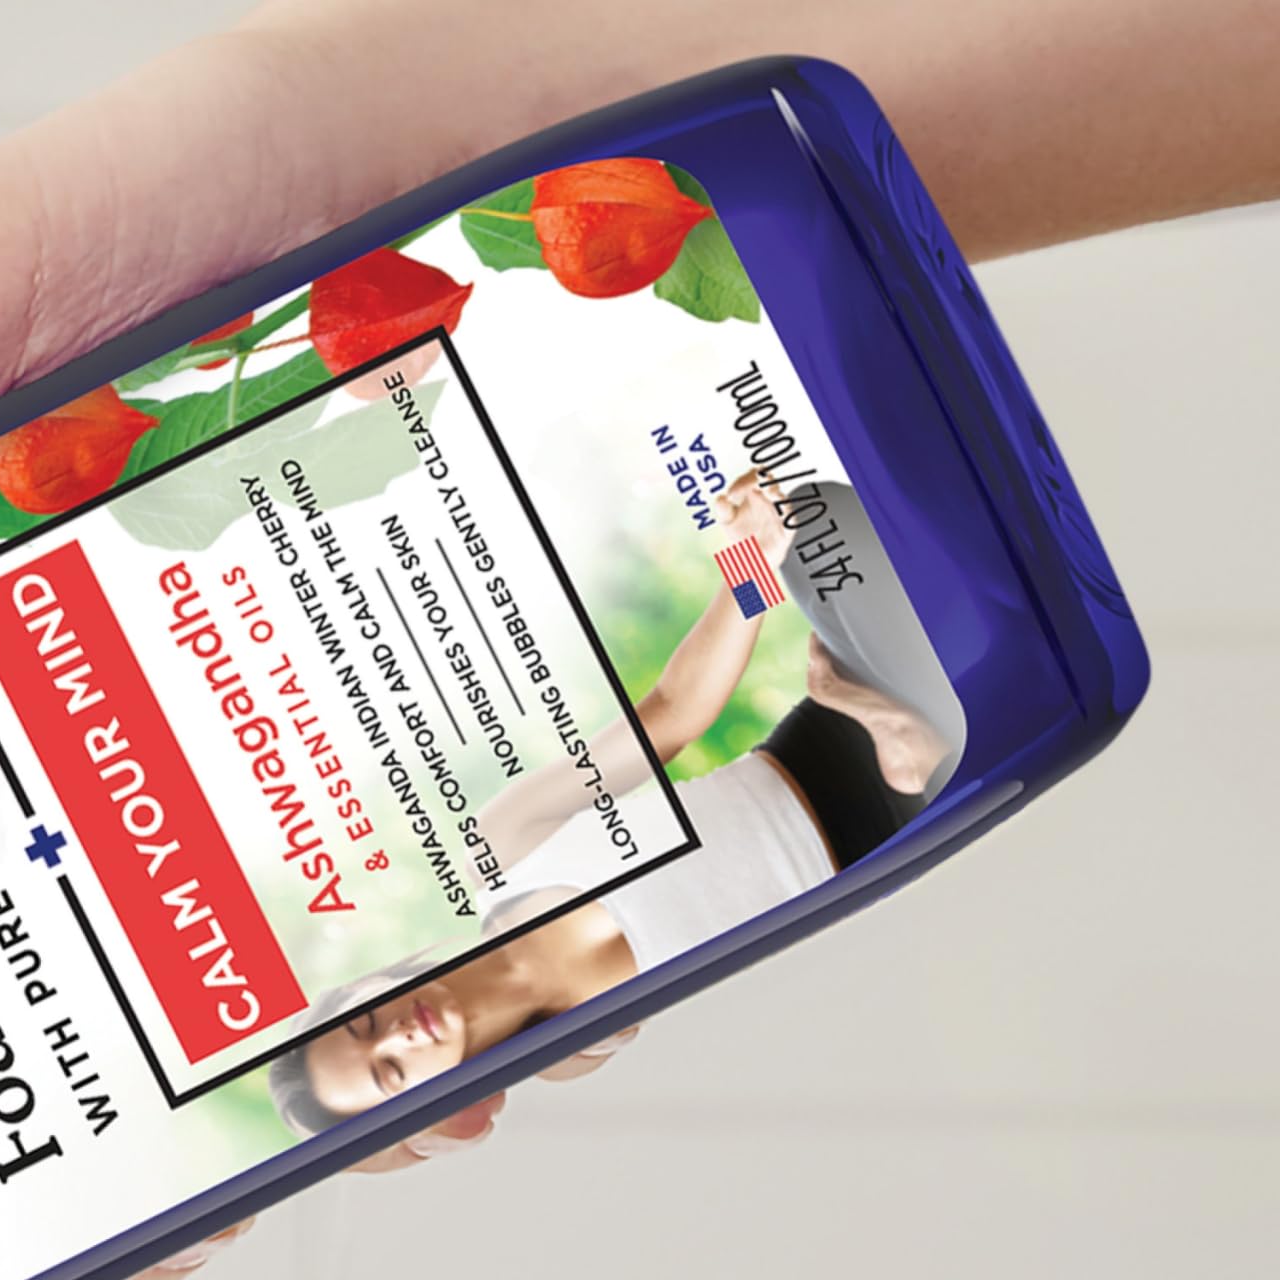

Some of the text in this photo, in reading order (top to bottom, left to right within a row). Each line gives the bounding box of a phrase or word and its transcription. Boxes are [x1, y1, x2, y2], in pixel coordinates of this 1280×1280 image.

[650, 424, 717, 531] MADE IN
[688, 432, 727, 495] USA
[773, 481, 829, 531] OZ
[794, 517, 846, 566] FL
[808, 554, 865, 604] 34
[158, 560, 357, 915] Ashwagandha
[221, 565, 391, 873] & ESSENTIAL OILS
[238, 475, 477, 917] ASHWAGANDA INDIAN WINTER CHERRY
[280, 459, 508, 892] HELPS COMFORT AND CALM THE MIND
[380, 513, 525, 779] NOURISHES YOUR SKIN
[382, 370, 640, 862] LONG-LASTING BUBBLES GENTLY CLEANSE
[11, 573, 261, 1031] CALM YOUR MIND
[42, 1016, 119, 1138] WITH
